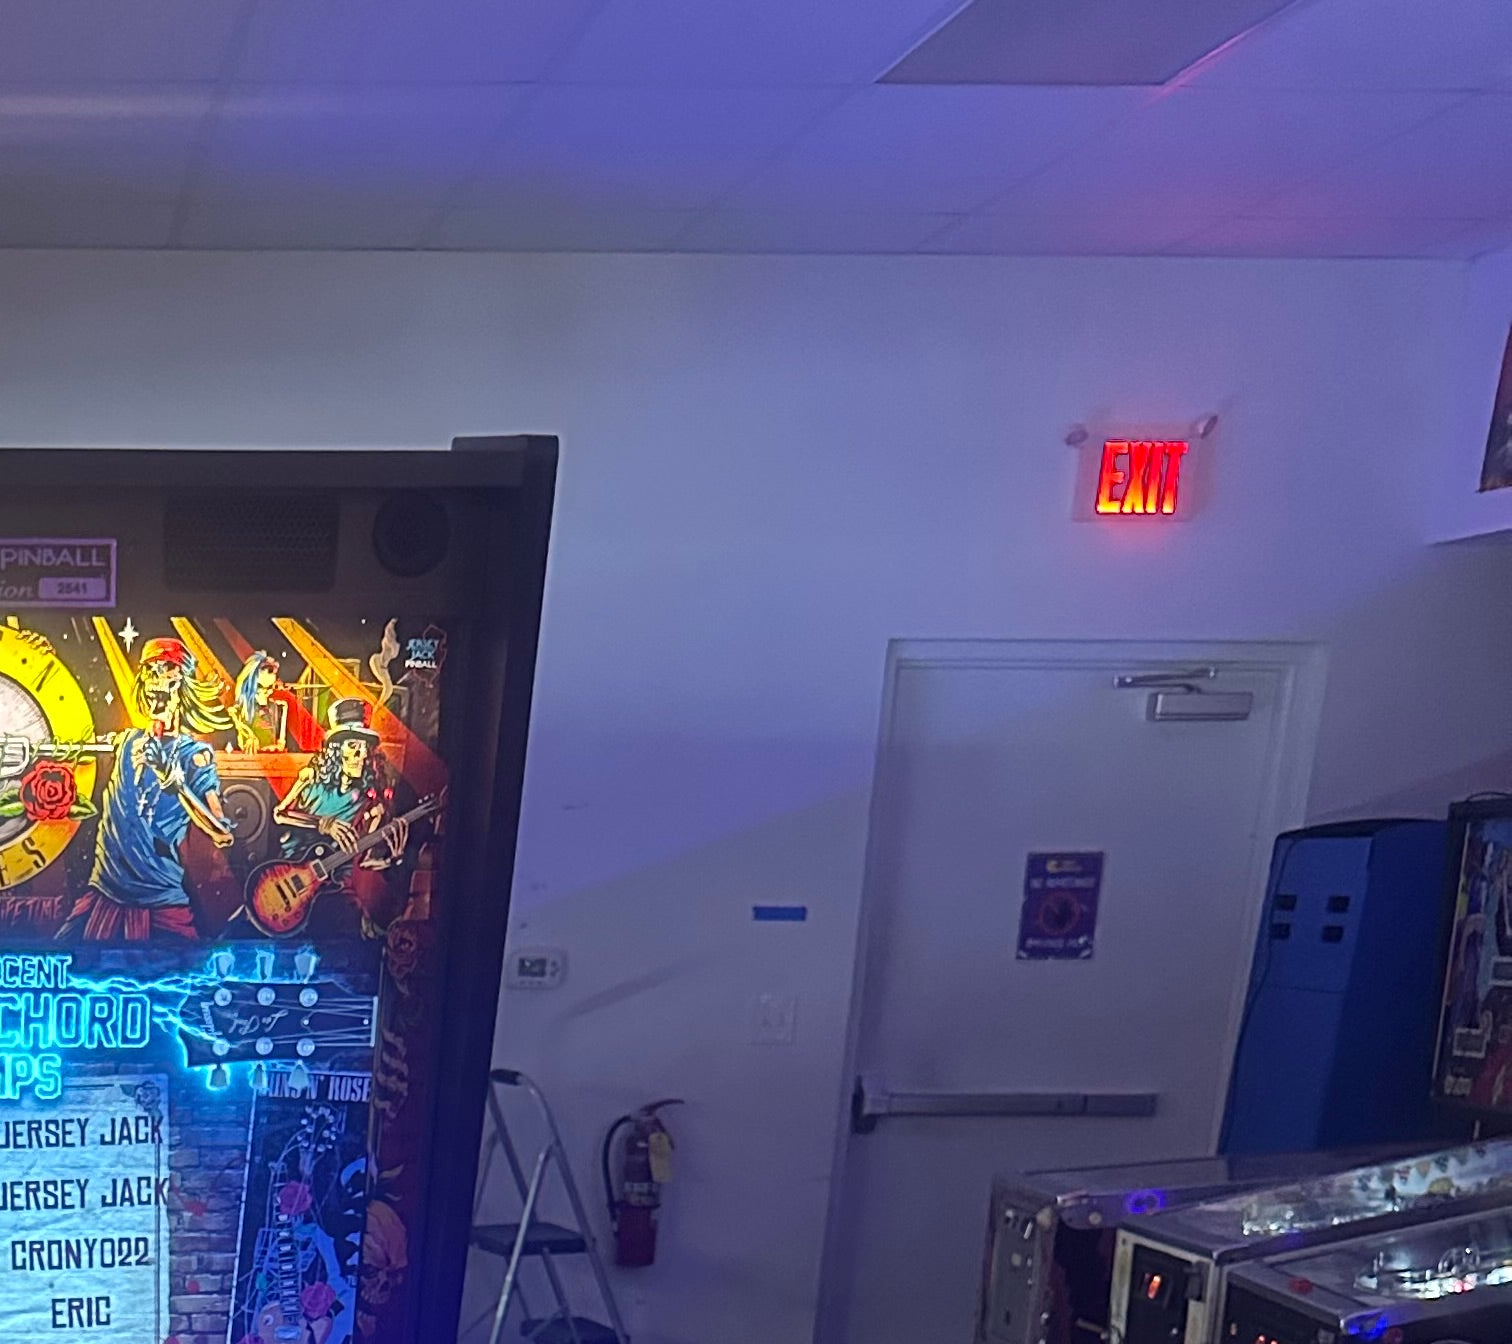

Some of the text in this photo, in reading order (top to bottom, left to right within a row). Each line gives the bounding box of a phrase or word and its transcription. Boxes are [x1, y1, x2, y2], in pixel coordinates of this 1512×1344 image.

[1096, 440, 1189, 514] EXIT
[0, 548, 106, 569] PINBALL
[99, 1115, 164, 1146] JACK
[100, 1176, 169, 1208] JACK
[51, 1296, 111, 1329] ERIC
